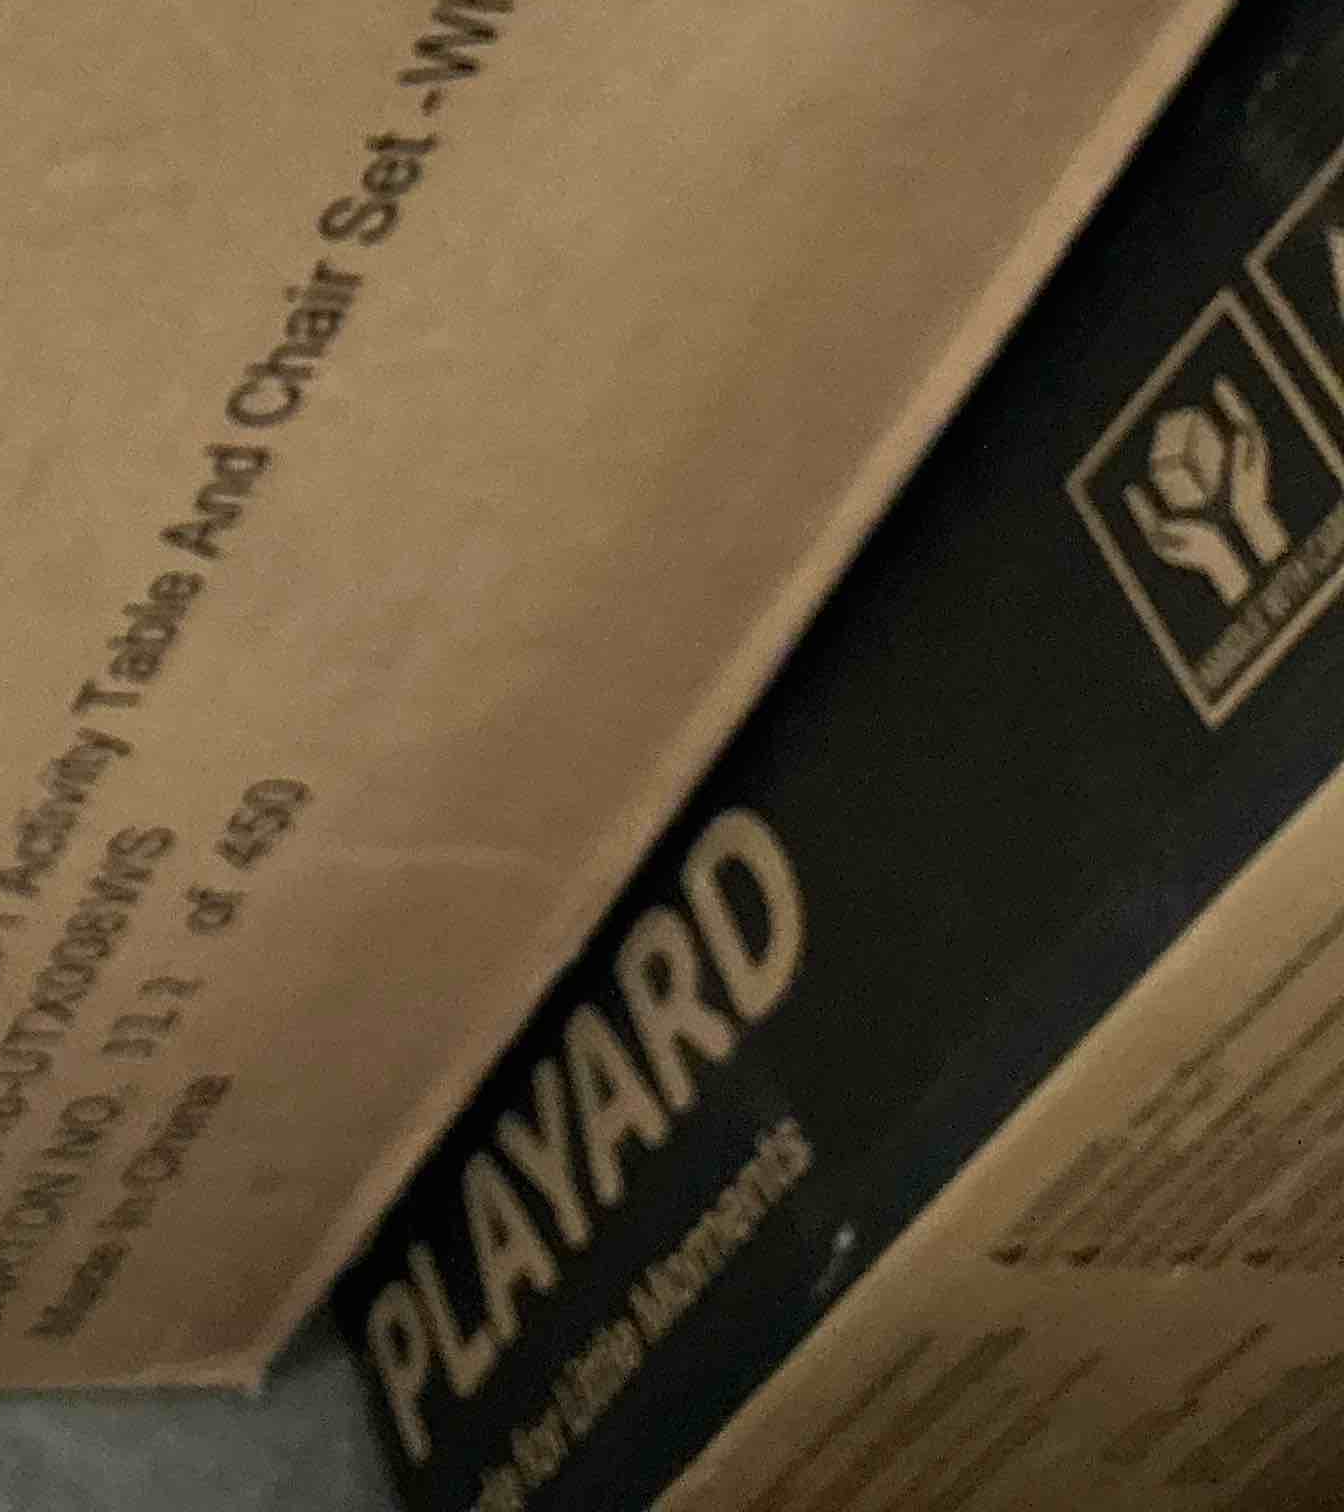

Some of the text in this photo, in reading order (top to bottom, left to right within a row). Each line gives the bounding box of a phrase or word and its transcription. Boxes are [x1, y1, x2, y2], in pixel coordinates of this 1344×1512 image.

[72, 569, 206, 715] Table
[159, 442, 272, 560] And
[223, 259, 363, 430] Chair
[317, 131, 440, 248] Set
[186, 884, 242, 935] of
[366, 806, 806, 1464] PLAYARD
[630, 1115, 813, 1341] Moments
